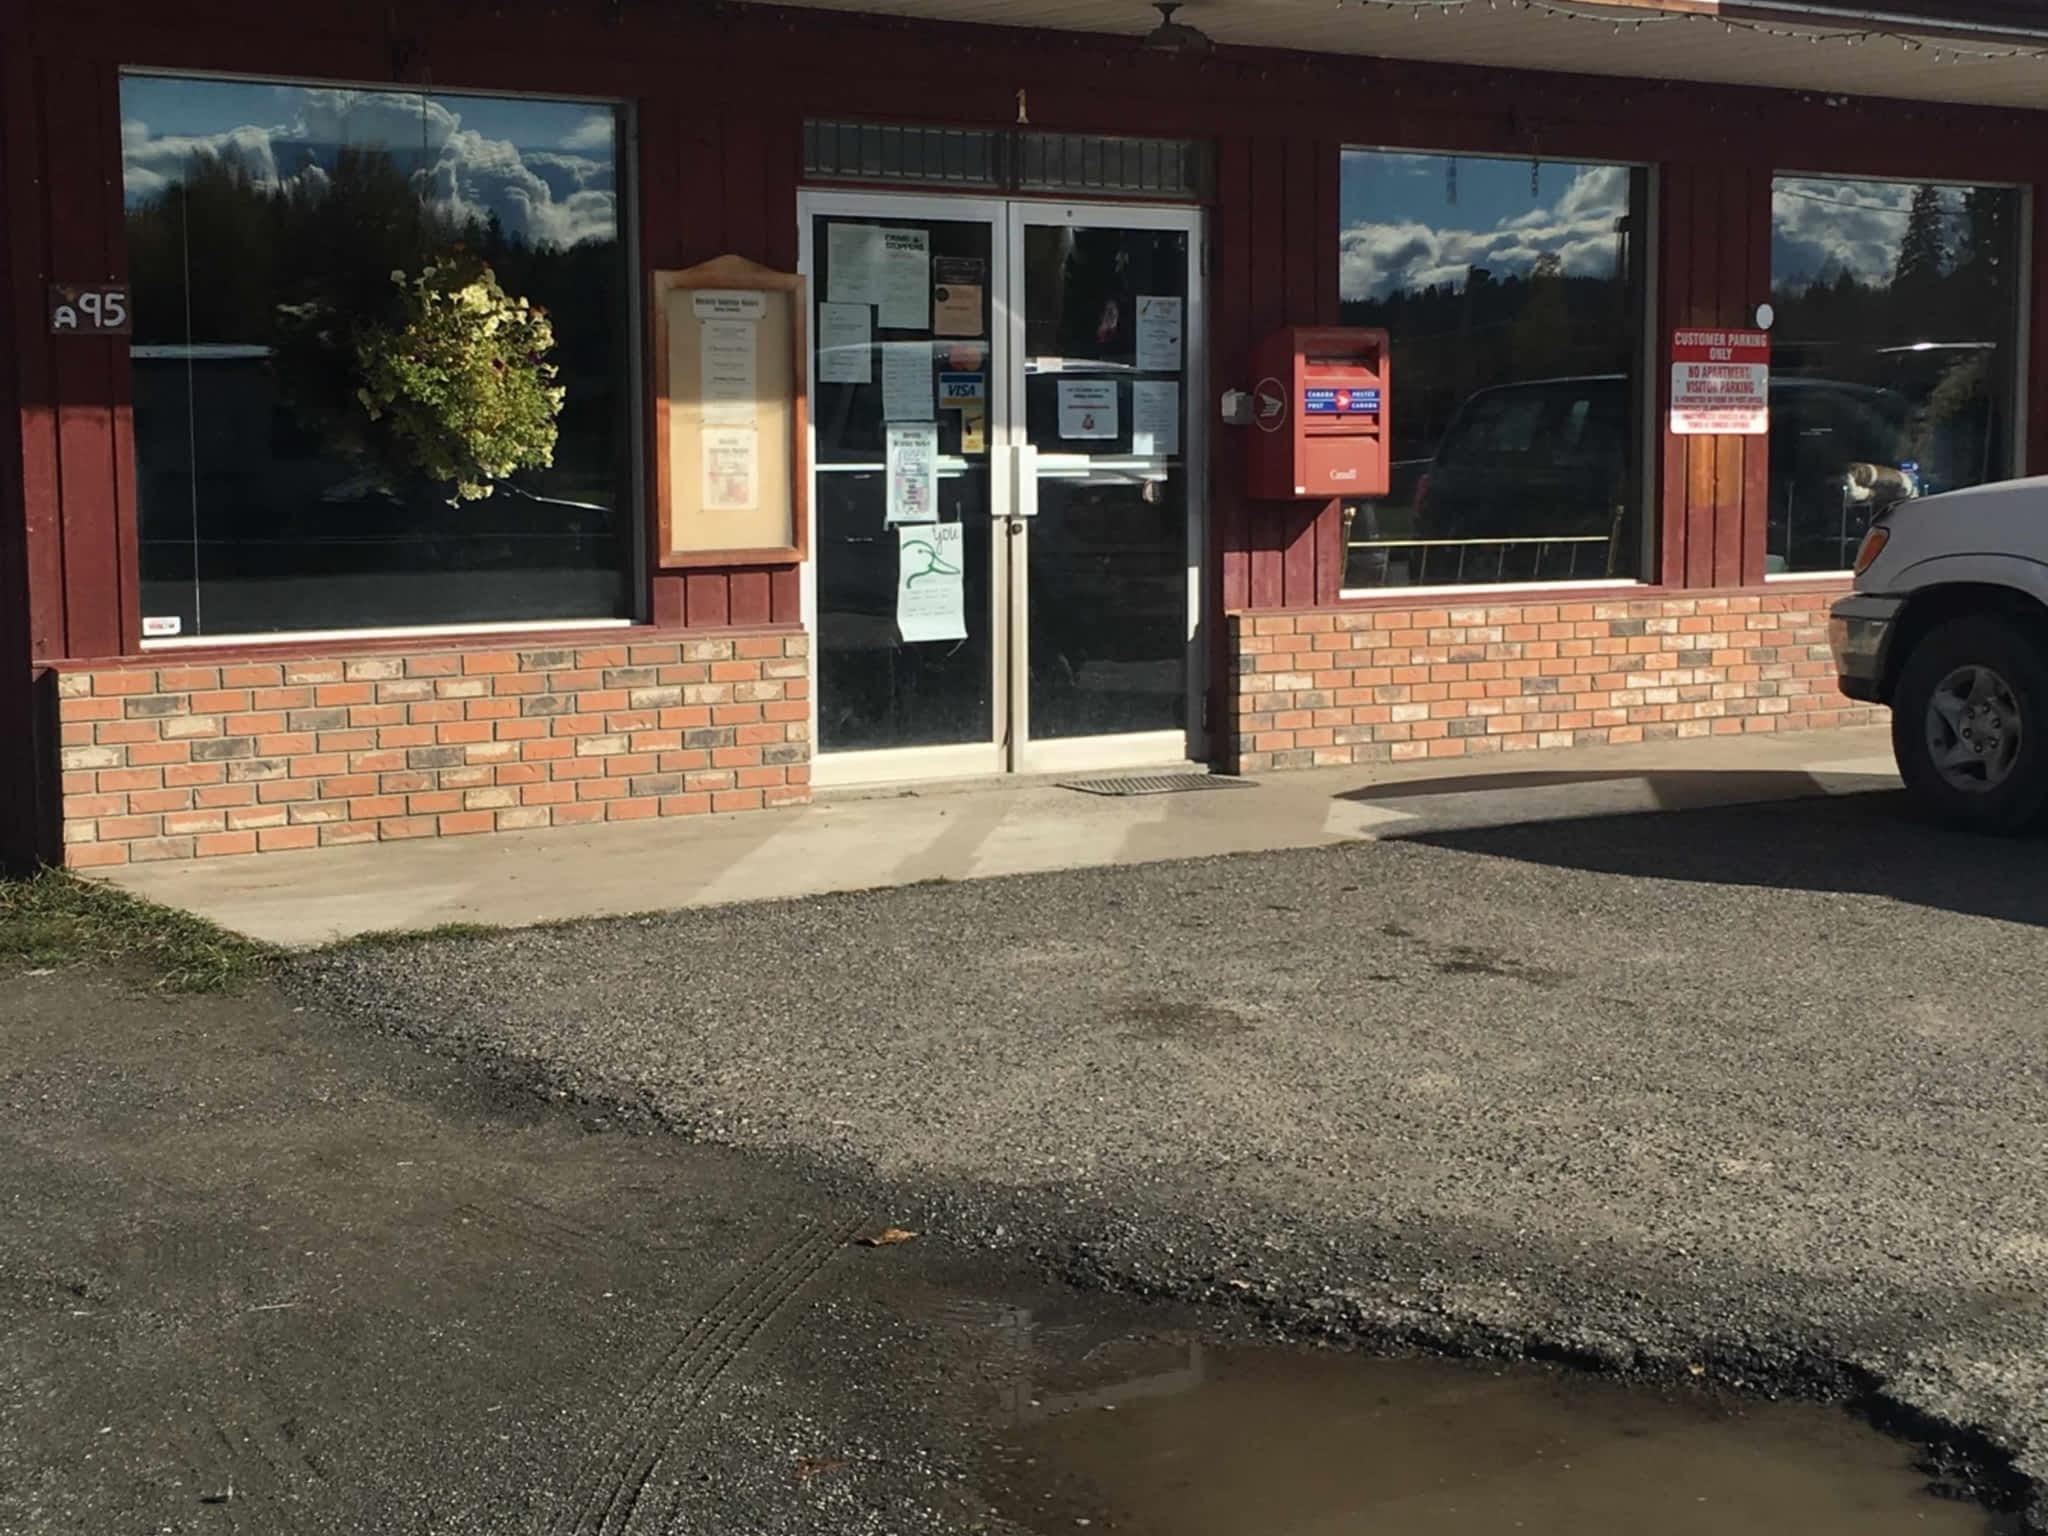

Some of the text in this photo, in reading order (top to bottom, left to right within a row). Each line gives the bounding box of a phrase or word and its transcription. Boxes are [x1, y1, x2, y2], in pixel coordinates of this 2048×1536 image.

[1016, 88, 1029, 124] 1
[1675, 332, 1767, 347] CUSTOMER PARKING
[1709, 347, 1732, 361] ONLY
[1688, 365, 1700, 378] NO
[948, 384, 976, 396] VISA
[1686, 381, 1755, 394] VISITOR PARKING
